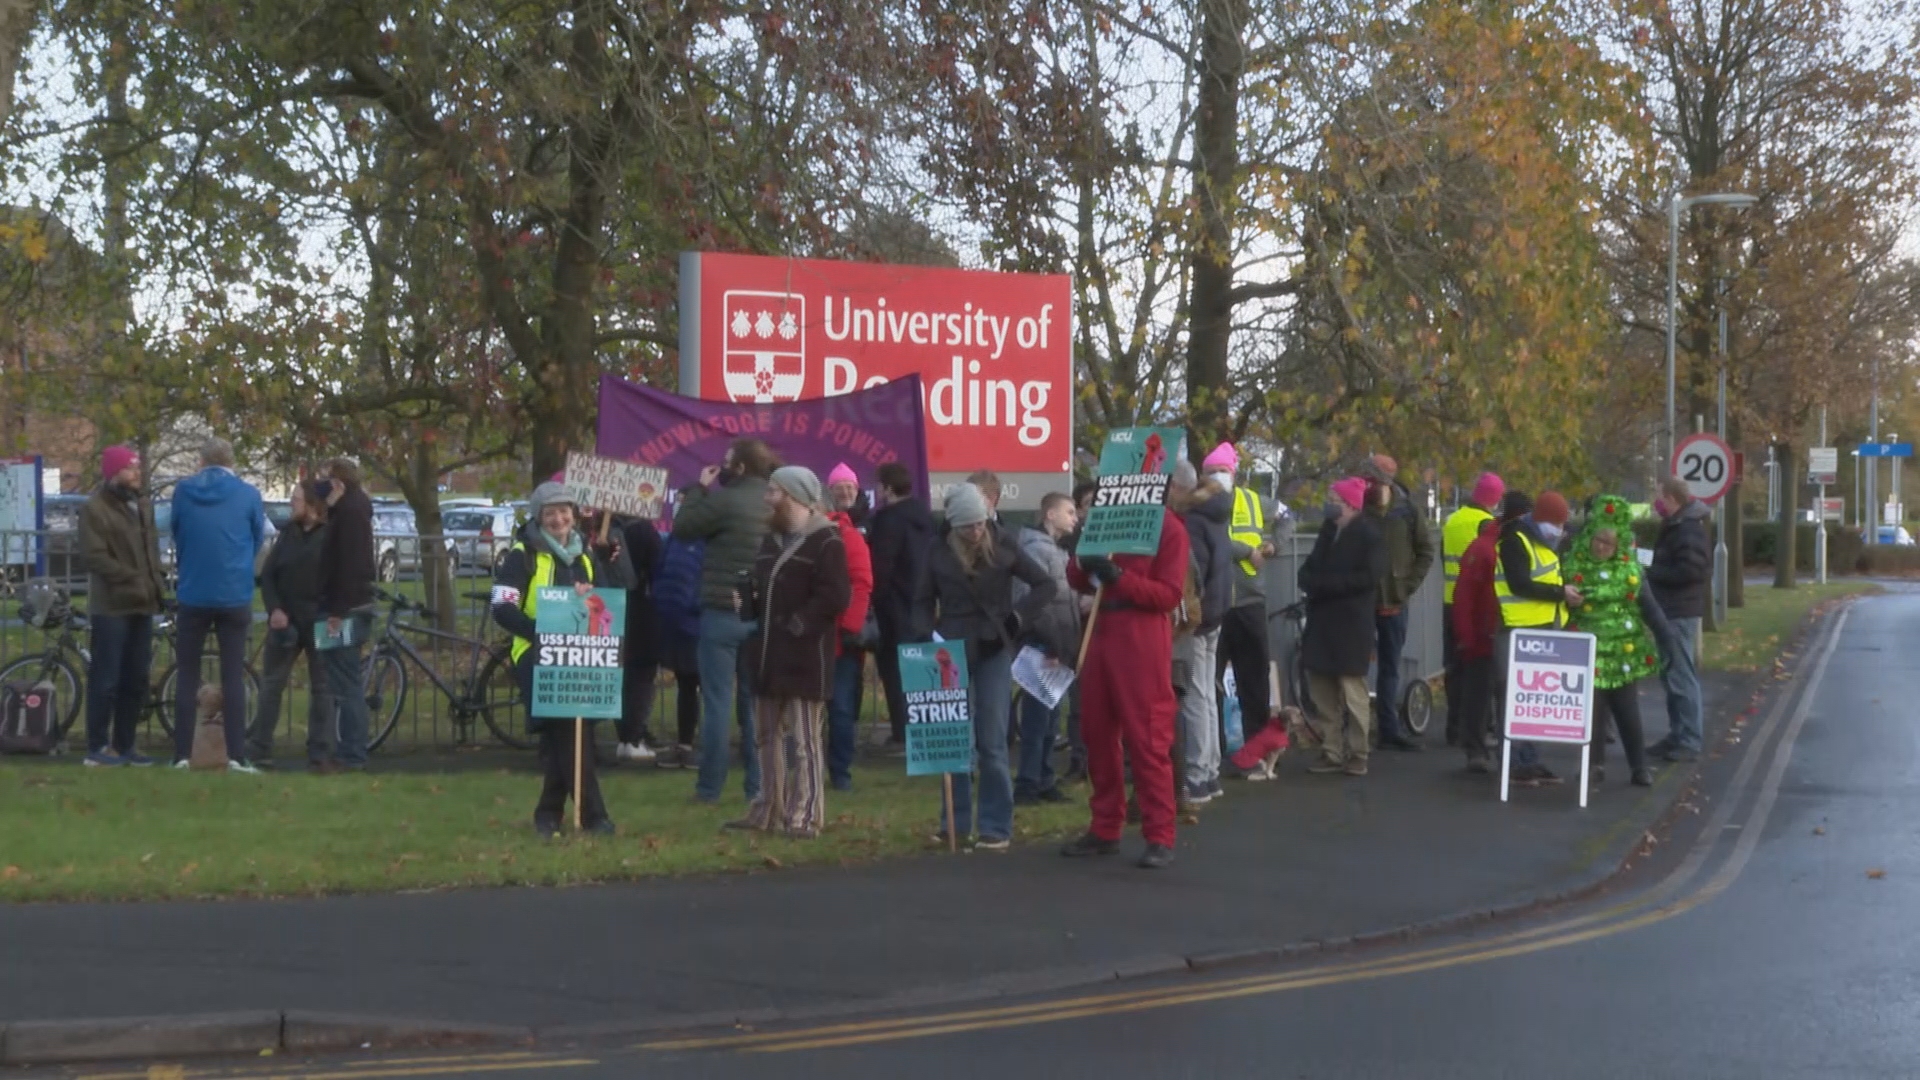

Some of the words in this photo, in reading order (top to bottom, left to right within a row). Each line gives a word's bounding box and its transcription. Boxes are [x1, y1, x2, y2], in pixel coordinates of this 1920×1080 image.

[824, 296, 1009, 358] University
[1016, 303, 1053, 349] of
[824, 356, 1052, 447] Rding
[784, 412, 809, 434] IS
[817, 417, 898, 466] POWER
[569, 453, 616, 474] FORCED
[625, 464, 662, 484] AGAIN
[1683, 453, 1724, 482] 20
[570, 469, 585, 483] TO
[589, 473, 635, 492] DEFEND
[1099, 475, 1119, 486] USS
[1120, 474, 1168, 485] PENSION
[1094, 486, 1165, 506] STRIKE
[1091, 511, 1105, 520] WE
[1107, 510, 1144, 519] EARNED
[1088, 521, 1102, 531] WE
[1104, 521, 1142, 530] DESERVE
[1085, 534, 1099, 543] WE
[1101, 532, 1139, 542] DEMAND
[539, 634, 564, 646] USS
[566, 635, 619, 647] PENSION
[539, 646, 619, 667] STRIKE
[539, 671, 555, 681] WE
[558, 671, 602, 681] EARNED
[538, 682, 554, 692] WE
[557, 682, 602, 693] DESERVE
[537, 694, 554, 704] WE
[557, 694, 602, 704] DEMAND
[906, 691, 924, 704] USS
[926, 688, 967, 702] PENSION
[1515, 692, 1583, 707] OFFICIAL
[907, 701, 969, 724] STRIKE
[1514, 705, 1583, 721] DISPUTE
[910, 728, 923, 738] WE
[925, 726, 958, 738] EARNED
[926, 738, 960, 749] DESERVE
[928, 751, 961, 761] DEMAND
